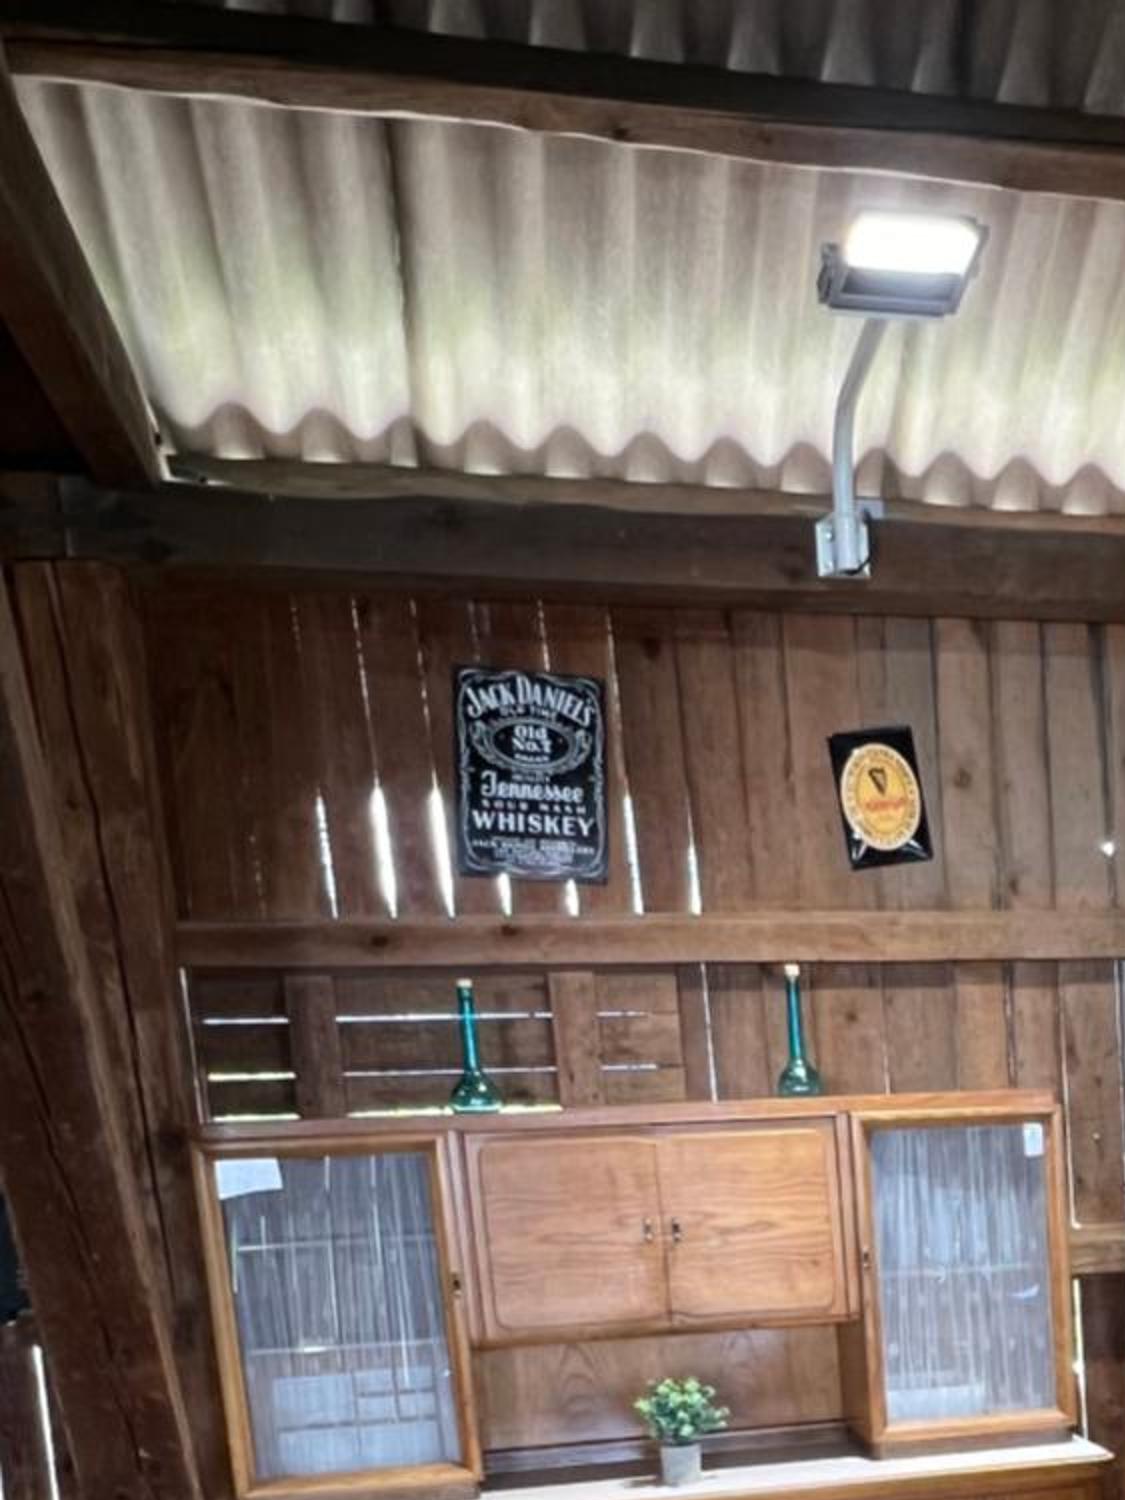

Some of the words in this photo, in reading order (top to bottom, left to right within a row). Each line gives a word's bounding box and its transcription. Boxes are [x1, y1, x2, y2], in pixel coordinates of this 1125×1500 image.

[467, 683, 516, 718] JACK
[513, 725, 548, 740] Old
[481, 769, 584, 803] Tennessee
[471, 809, 594, 837] WHISKEY
